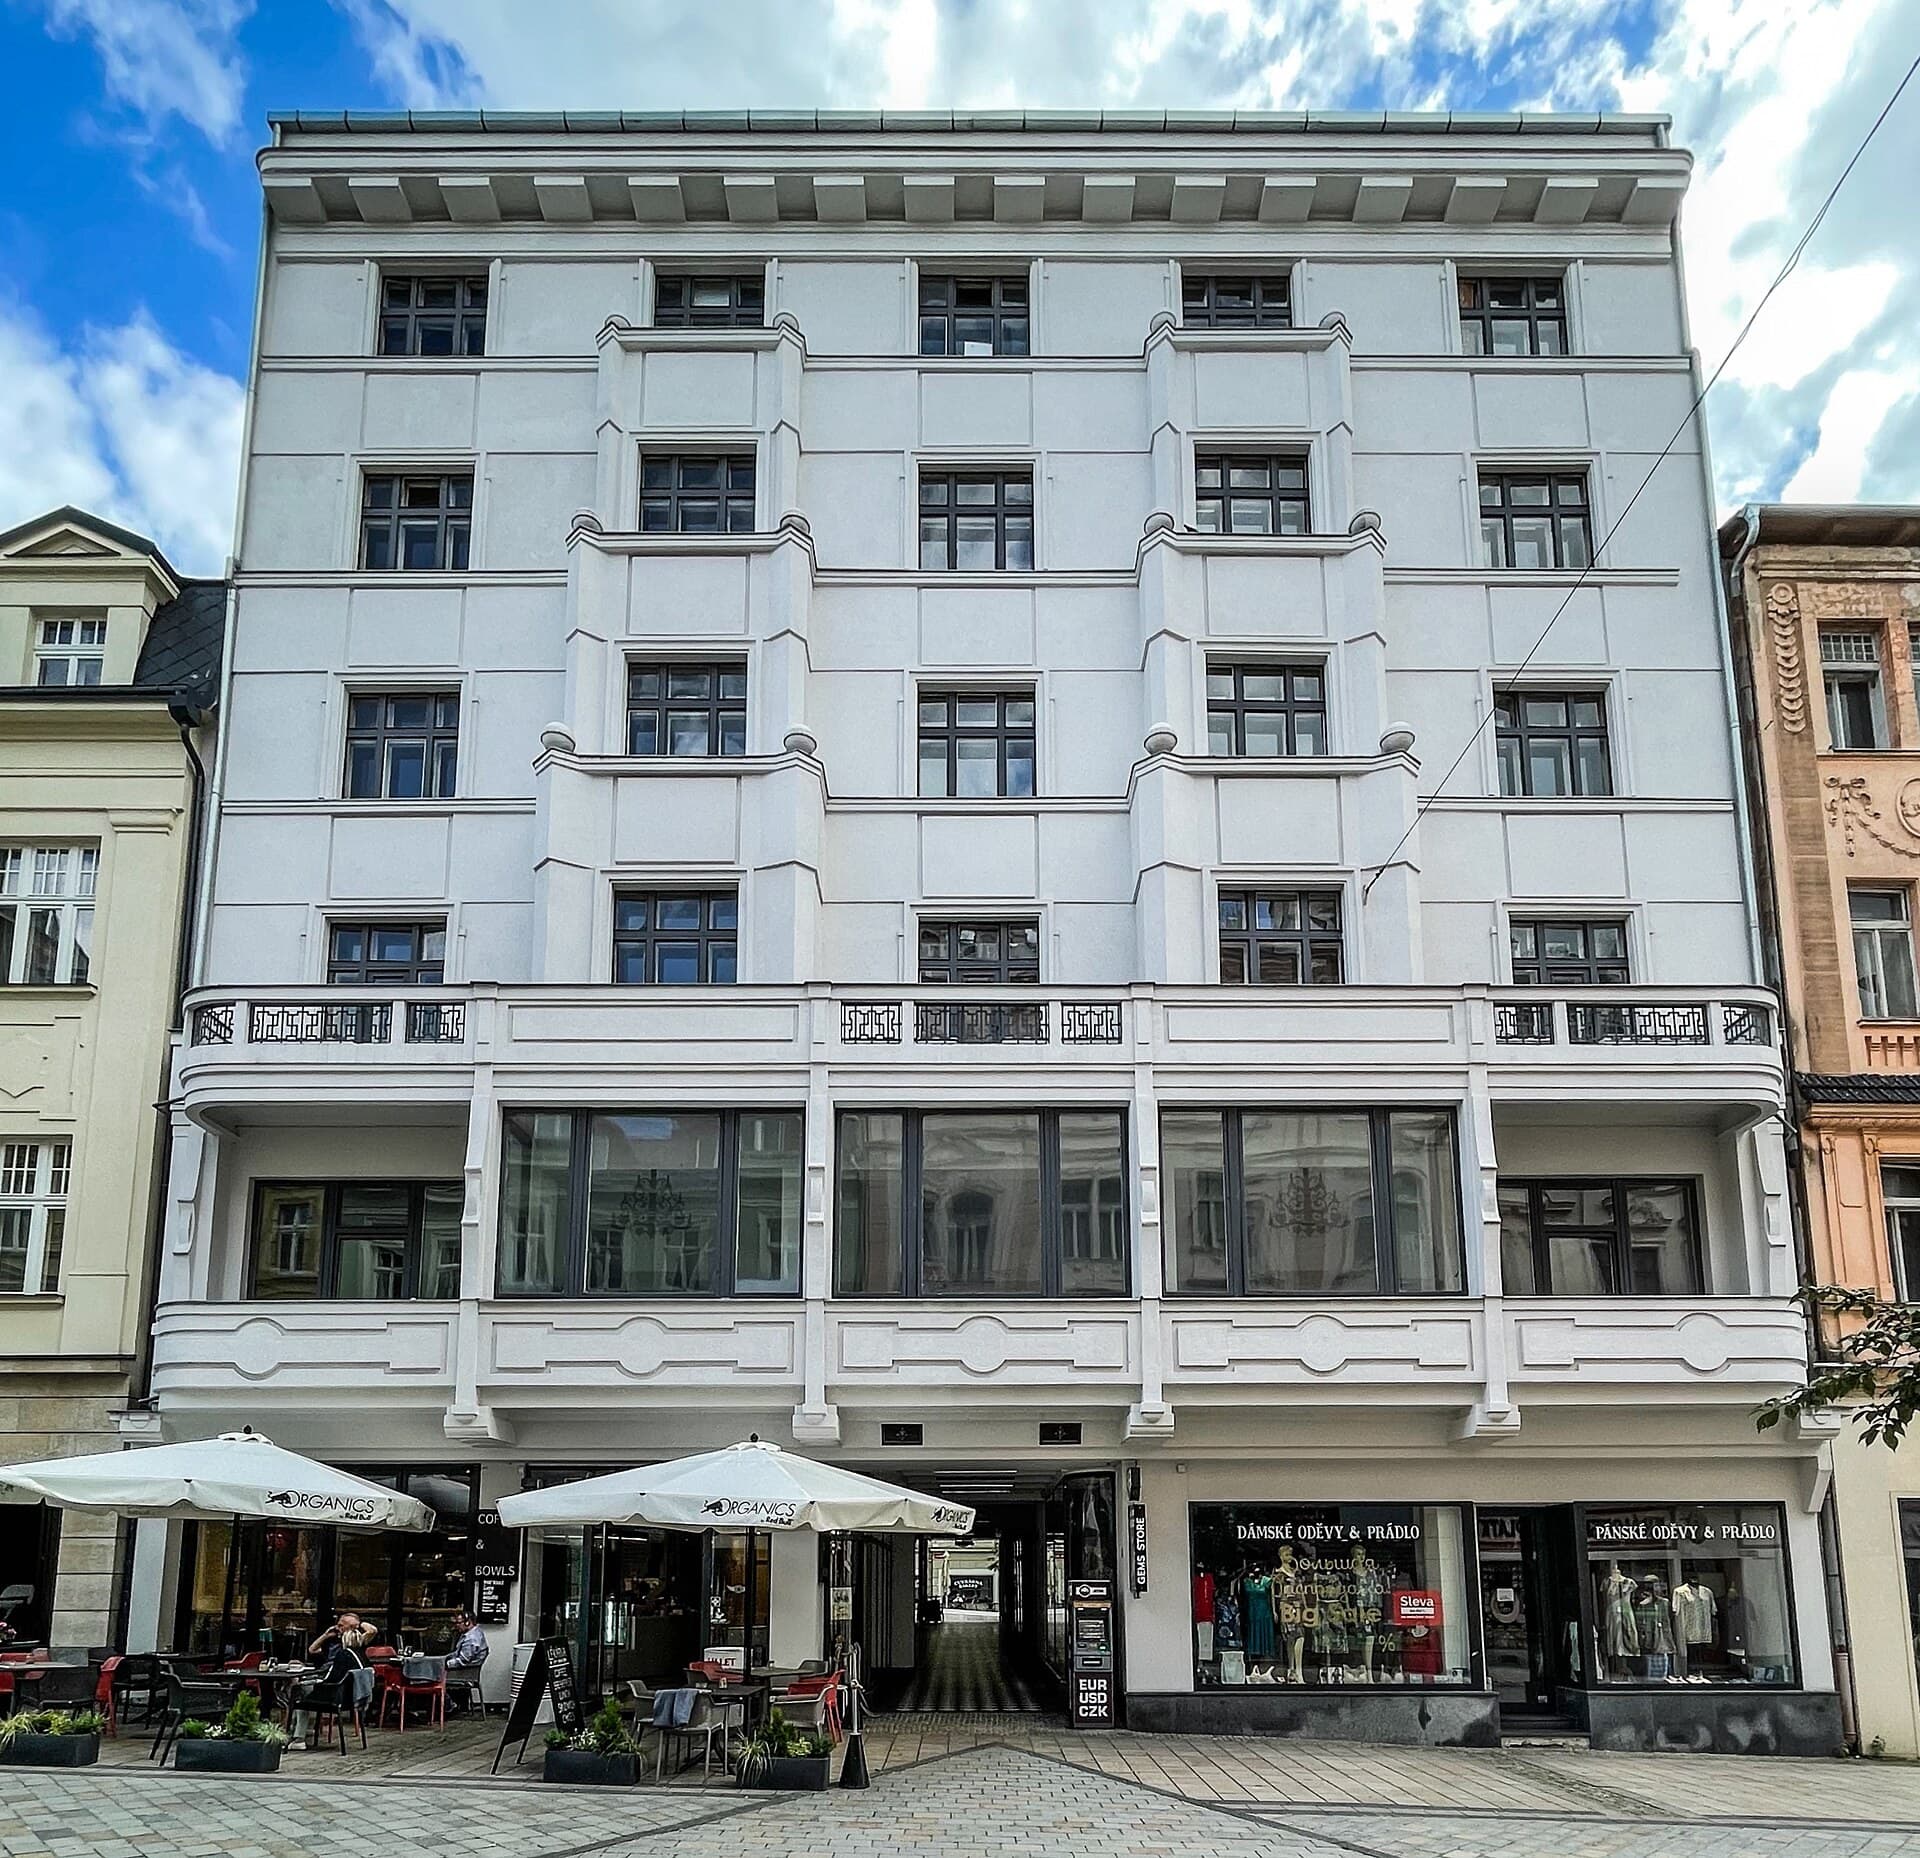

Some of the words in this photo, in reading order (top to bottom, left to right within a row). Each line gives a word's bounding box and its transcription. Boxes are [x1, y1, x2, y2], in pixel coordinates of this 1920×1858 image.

[281, 1490, 375, 1514] ORGANICS
[711, 1498, 797, 1517] ORGANICS
[1136, 1517, 1145, 1551] STORE
[1236, 1523, 1293, 1540] DÁMSKÉ
[1298, 1523, 1344, 1540] ODĚVY
[1349, 1525, 1360, 1539] &
[1367, 1523, 1420, 1540] PRÁDLO
[1595, 1523, 1647, 1540] PÁNSKÉ
[1652, 1523, 1698, 1540] ODĚVY
[1704, 1526, 1715, 1538] &
[1722, 1523, 1775, 1539] PRÁDLO
[475, 1539, 485, 1550] &
[475, 1565, 516, 1577] BOWLS
[1137, 1555, 1146, 1585] GEMS
[1400, 1595, 1435, 1607] Sleva
[1280, 1601, 1320, 1628] Big
[1378, 1632, 1396, 1653] %
[1079, 1679, 1108, 1691] EUR
[1079, 1692, 1108, 1704] USD
[1079, 1705, 1109, 1717] CZK
